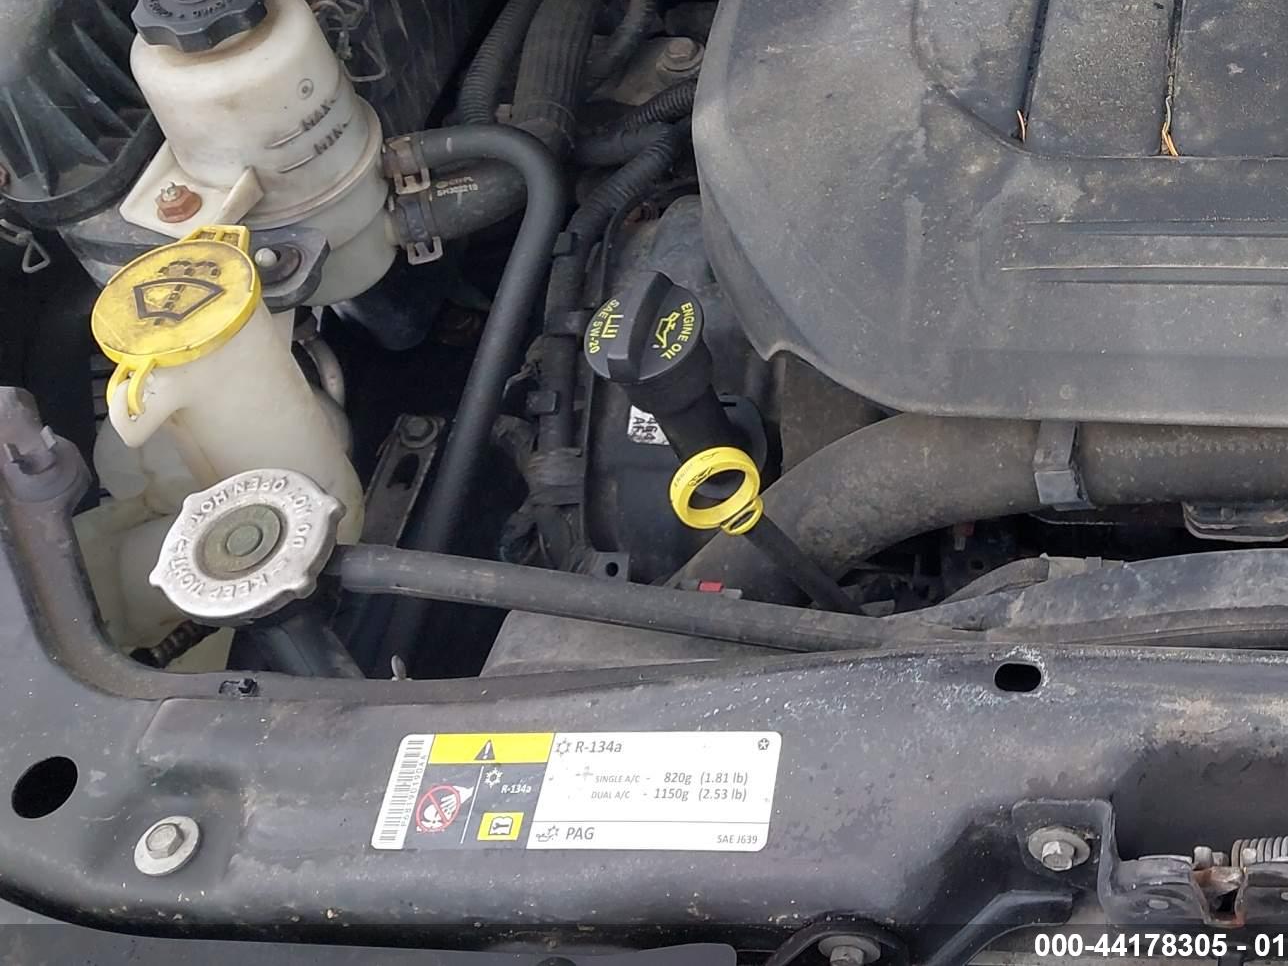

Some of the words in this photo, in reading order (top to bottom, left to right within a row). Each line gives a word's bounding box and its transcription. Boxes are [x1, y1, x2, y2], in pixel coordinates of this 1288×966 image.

[597, 299, 620, 319] SAE
[676, 302, 695, 342] ENGINE
[588, 321, 604, 354] 5W-20
[660, 344, 683, 361] OIL
[233, 476, 288, 495] OPEN
[191, 491, 229, 524] HOT
[575, 740, 622, 754] R-134a
[595, 775, 622, 784] SINGLE
[624, 774, 641, 784] A/C
[663, 772, 692, 786] 820g
[699, 771, 729, 785] (1.81
[732, 771, 749, 785] lb)
[501, 782, 532, 794] R-134a
[591, 791, 611, 801] DUAL
[613, 791, 630, 801] A/C
[654, 789, 689, 803] 1150g
[698, 788, 728, 802] (2.53
[731, 788, 748, 802] lb)
[565, 827, 595, 841] PAG
[717, 834, 735, 844] SAE
[737, 834, 758, 845] J639
